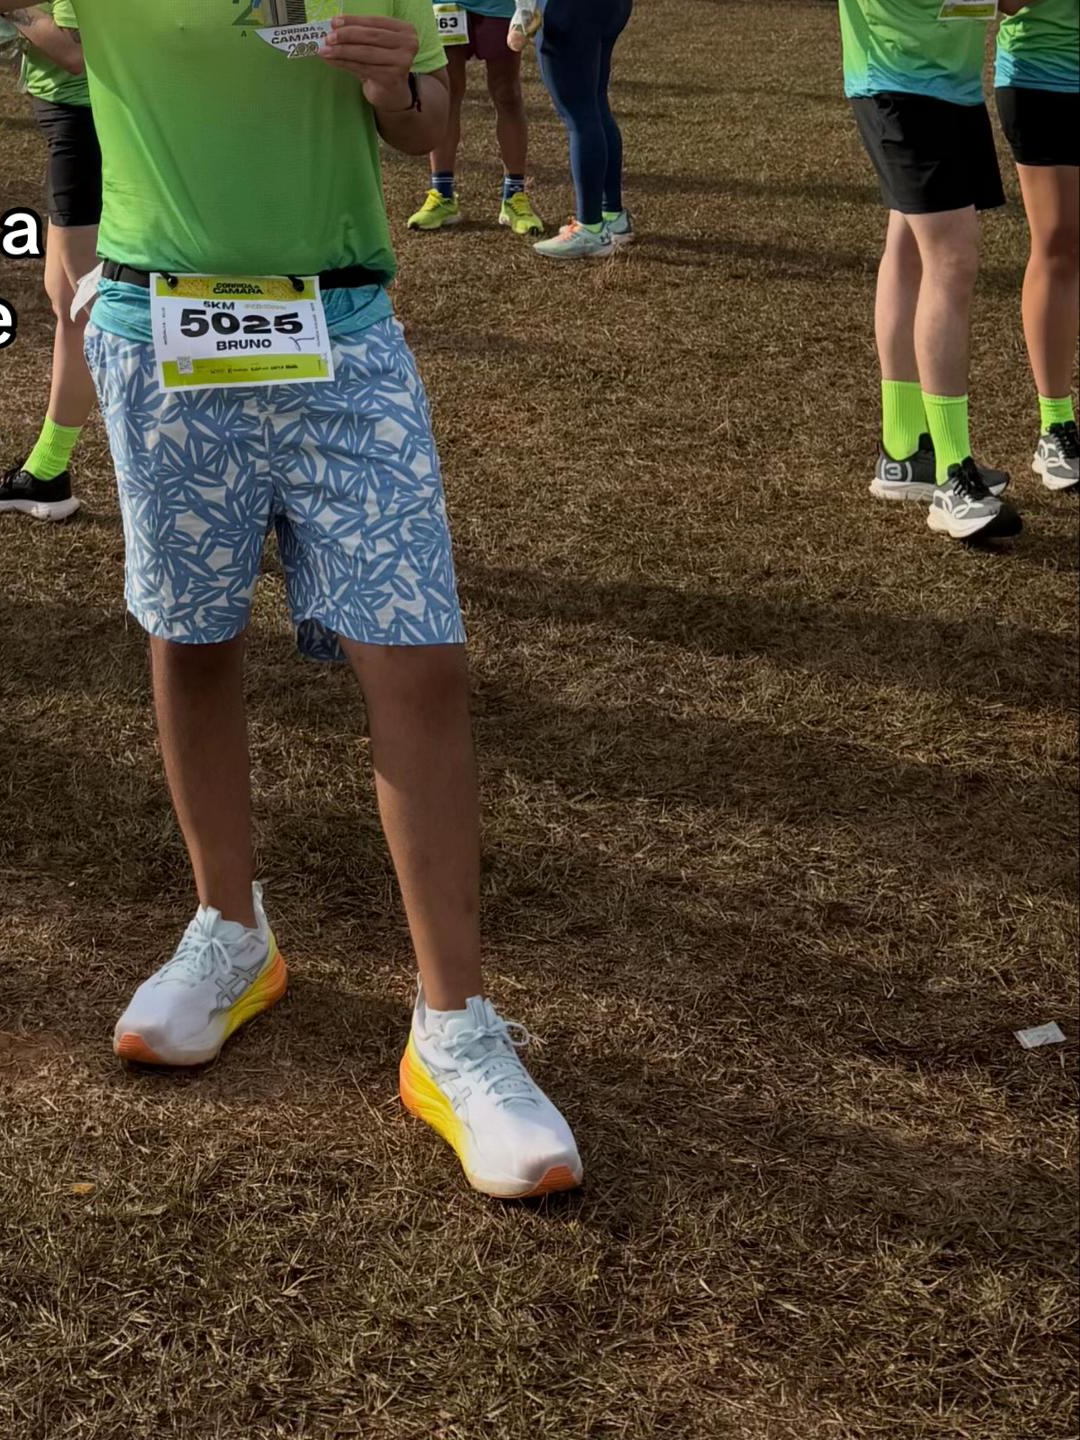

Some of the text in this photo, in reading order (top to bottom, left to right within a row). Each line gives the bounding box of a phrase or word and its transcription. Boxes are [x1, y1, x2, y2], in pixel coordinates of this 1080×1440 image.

[203, 300, 236, 311] 5KM
[179, 308, 304, 338] 5025
[215, 338, 273, 352] BRUNO
